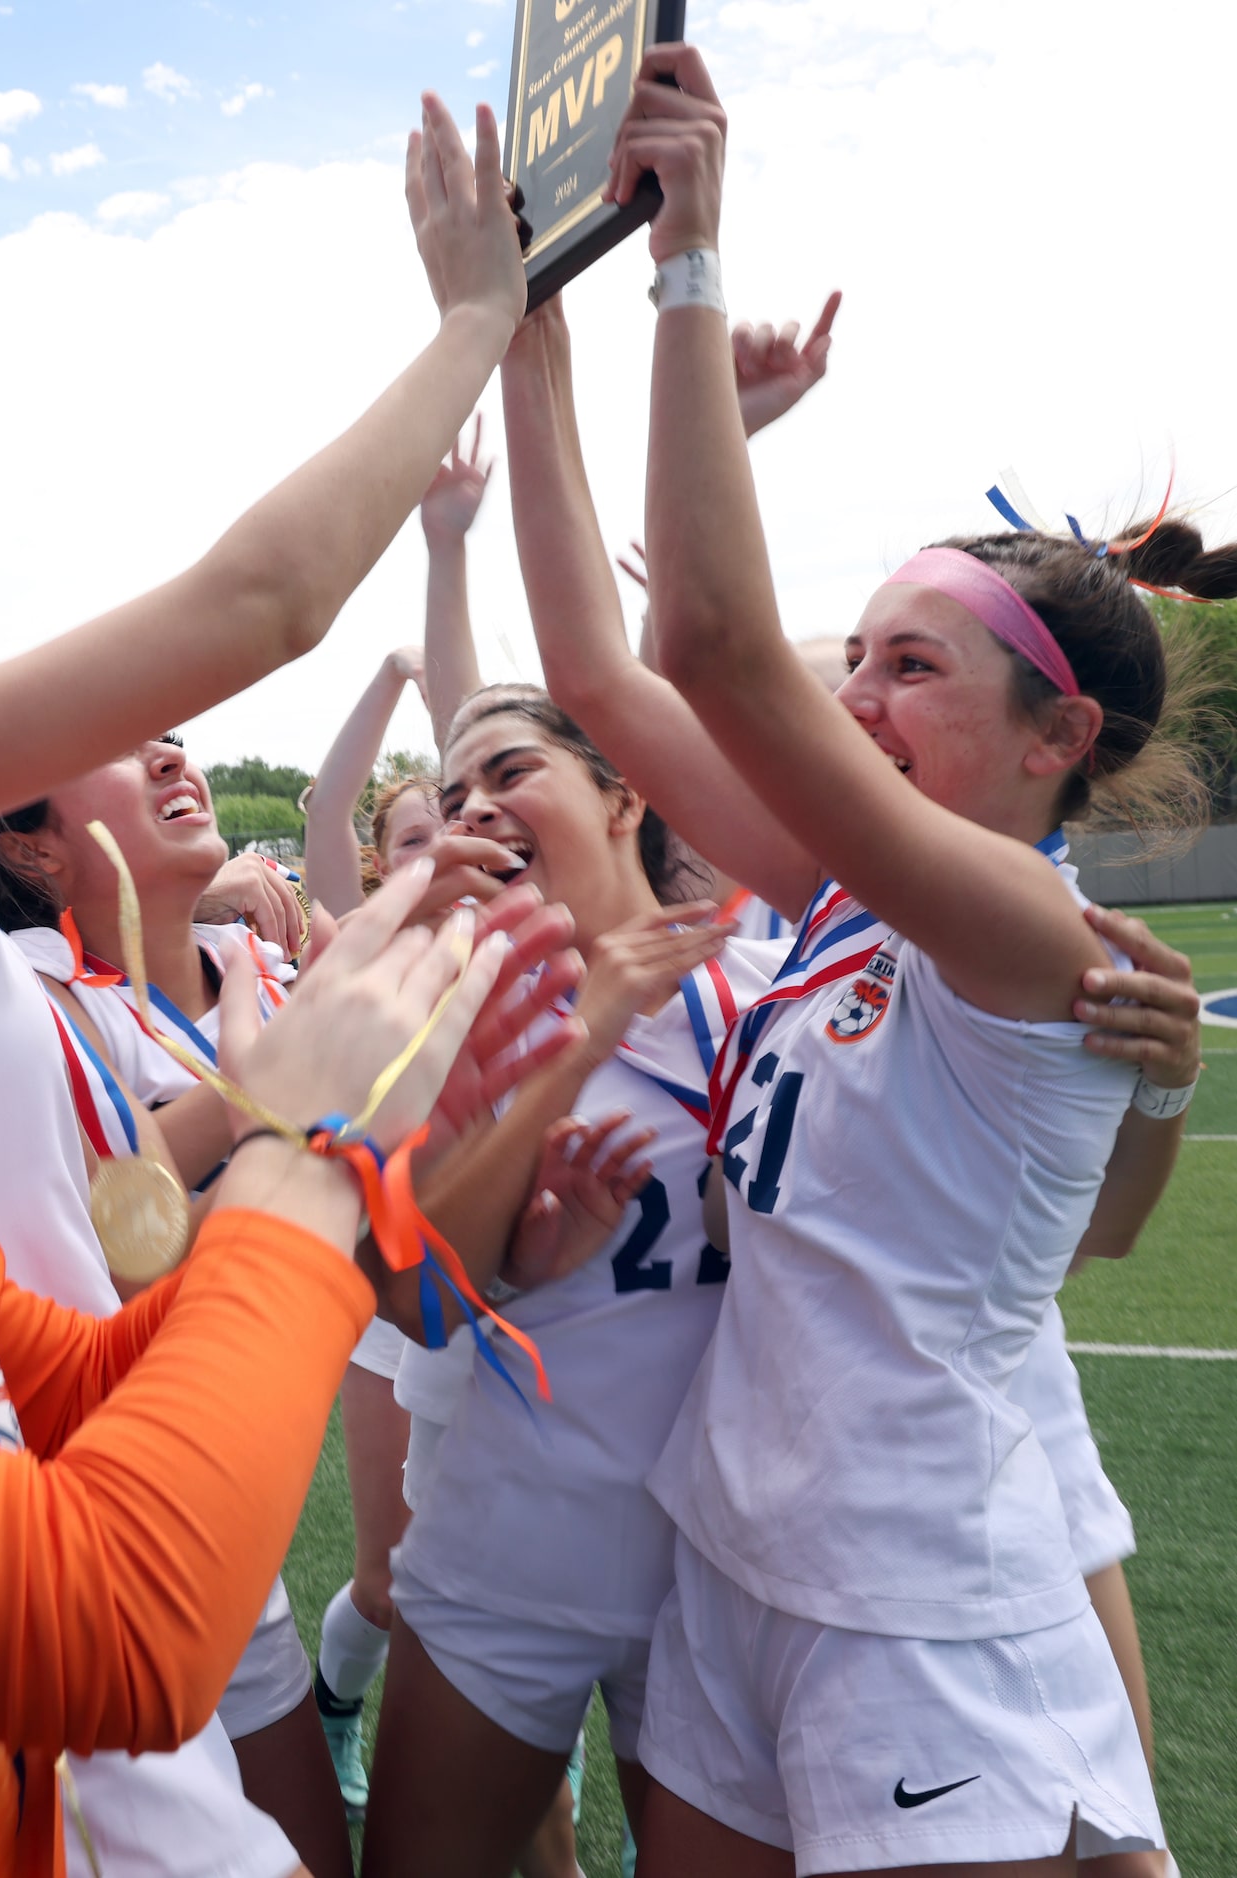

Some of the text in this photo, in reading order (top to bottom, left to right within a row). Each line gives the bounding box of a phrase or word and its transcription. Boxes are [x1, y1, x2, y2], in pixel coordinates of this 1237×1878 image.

[563, 4, 597, 45] Soccer
[526, 33, 623, 168] MVP
[528, 70, 552, 101] State
[723, 1051, 804, 1215] 21
